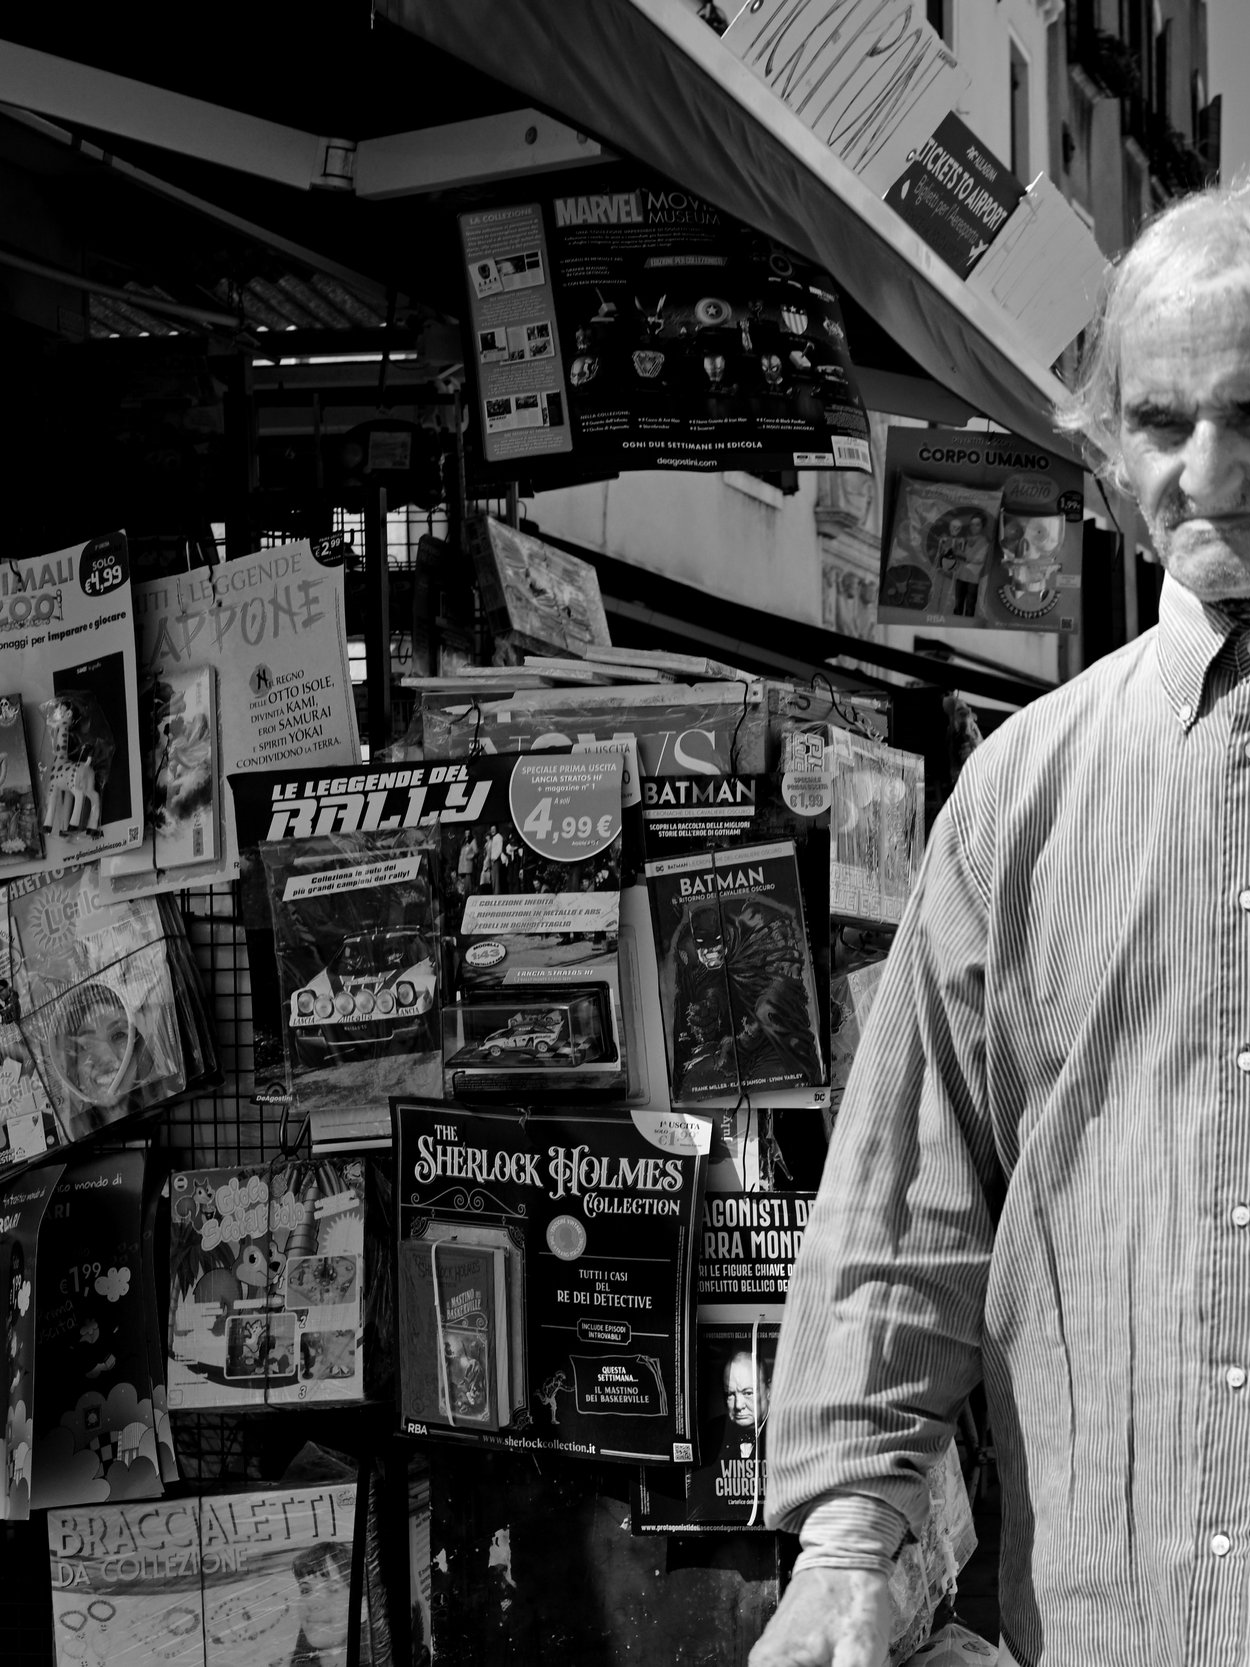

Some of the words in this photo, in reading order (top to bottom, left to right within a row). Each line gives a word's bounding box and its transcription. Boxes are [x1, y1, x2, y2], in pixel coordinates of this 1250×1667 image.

[918, 136, 963, 190] TICKETS
[953, 171, 974, 200] TO
[964, 186, 1008, 232] AIRPORT
[556, 192, 644, 227] MARVEL
[647, 192, 716, 211] MOV
[481, 207, 534, 224] COLLEZIONE
[649, 209, 721, 225] MUSEUM
[622, 441, 647, 449] OGNI
[648, 441, 666, 449] DUE
[667, 441, 713, 451] SETTIMANE
[714, 441, 725, 449] IN
[726, 440, 763, 449] EDICOLA
[656, 456, 717, 467] deagostini.com
[918, 447, 981, 465] CORPO
[984, 450, 1049, 470] UMANO
[92, 555, 115, 572] SOLO
[84, 564, 123, 595] €4,99
[189, 553, 302, 604] LEGGENDE
[0, 592, 55, 623] OO
[31, 634, 46, 648] per
[47, 623, 88, 642] imparare
[88, 622, 93, 630] e
[94, 610, 127, 631] giocare
[276, 669, 305, 686] REGNO
[268, 685, 299, 705] OTTO
[302, 675, 335, 696] ISOLE,
[286, 695, 318, 715] KAMI,
[258, 724, 277, 737] EROI
[278, 705, 332, 731] SAMURAI
[236, 746, 303, 769] CONDIVIDONO
[312, 736, 342, 752] TERRA.
[258, 737, 288, 752] SPIRITI
[522, 764, 558, 776] SPECIALE
[559, 763, 587, 774] PRIMA
[589, 762, 617, 773] USCITA
[271, 782, 298, 801] LE
[303, 769, 425, 798] LEGGENDE
[428, 764, 470, 785] DEL
[531, 775, 558, 784] LANCIA
[560, 774, 590, 783] STRATOS
[592, 774, 602, 782] HF
[544, 784, 579, 795] magazine
[644, 779, 756, 805] BATMAN
[266, 780, 493, 841] RALLY
[523, 797, 593, 845] 4,99
[596, 814, 613, 838] €
[650, 823, 669, 831] SCOPRI
[678, 822, 705, 830] RACCOLTA
[724, 821, 750, 829] MIGLIORI
[659, 830, 678, 838] STORIE
[679, 829, 707, 838] DELL'EROE
[311, 870, 353, 885] Colleziona
[354, 869, 363, 878] le
[364, 866, 382, 877] auto
[656, 864, 664, 873] DC
[667, 863, 688, 871] BATMAN
[307, 882, 335, 896] grandi
[336, 876, 373, 891] campioni
[388, 869, 410, 883] rally!
[680, 866, 766, 897] BATMAN
[679, 894, 705, 904] RITORNO
[719, 886, 750, 898] CAVALIERE
[751, 883, 776, 893] OSCURO
[478, 899, 523, 908] COLLEZIONE
[524, 898, 554, 906] INEDITA
[543, 909, 577, 917] METALLO
[516, 969, 545, 978] LANCIA
[547, 968, 583, 977] STRATOS
[692, 1085, 708, 1093] FRANK
[709, 1082, 727, 1091] MILLER
[747, 1078, 766, 1087] JANSON
[769, 1075, 782, 1083] LYNN
[784, 1073, 803, 1081] VARLEY
[256, 1094, 293, 1103] DeAgostini
[814, 1092, 826, 1102] DC
[434, 1124, 458, 1142] THE
[668, 1121, 700, 1130] USCITA
[414, 1135, 544, 1188] SHERLOCK
[548, 1145, 685, 1200] HOLMES
[74, 1175, 109, 1192] mondo
[112, 1172, 123, 1186] di
[583, 1192, 681, 1218] COLLECTION
[700, 1231, 744, 1260] RRA
[578, 1269, 602, 1280] TUTTI
[604, 1271, 608, 1281] I
[609, 1271, 628, 1282] CASI
[711, 1264, 720, 1278] LE
[722, 1264, 753, 1277] FIGURE
[755, 1263, 785, 1277] CHIAVE
[596, 1282, 611, 1292] DEL
[741, 1279, 775, 1292] BELLICO
[557, 1290, 570, 1303] RE
[573, 1291, 590, 1305] DEI
[593, 1293, 653, 1310] DETECTIVE
[446, 1300, 482, 1321] BASKERVILLE
[581, 1322, 604, 1332] INCLUDE
[604, 1324, 627, 1334] EPISODI
[588, 1331, 621, 1341] INTROVABILI
[601, 1366, 626, 1375] QUESTA
[298, 1385, 307, 1399] 3
[585, 1394, 598, 1403] DEI
[600, 1395, 650, 1404] BASKERVILLE
[594, 1386, 603, 1394] IL
[604, 1386, 639, 1395] MASTINO
[407, 1423, 428, 1436] RBA
[482, 1434, 597, 1455] www.sherlockcollection.it
[57, 1494, 337, 1559] BRACCIALETTI
[57, 1562, 91, 1588] DA
[103, 1548, 248, 1583] COLLEZIONE
